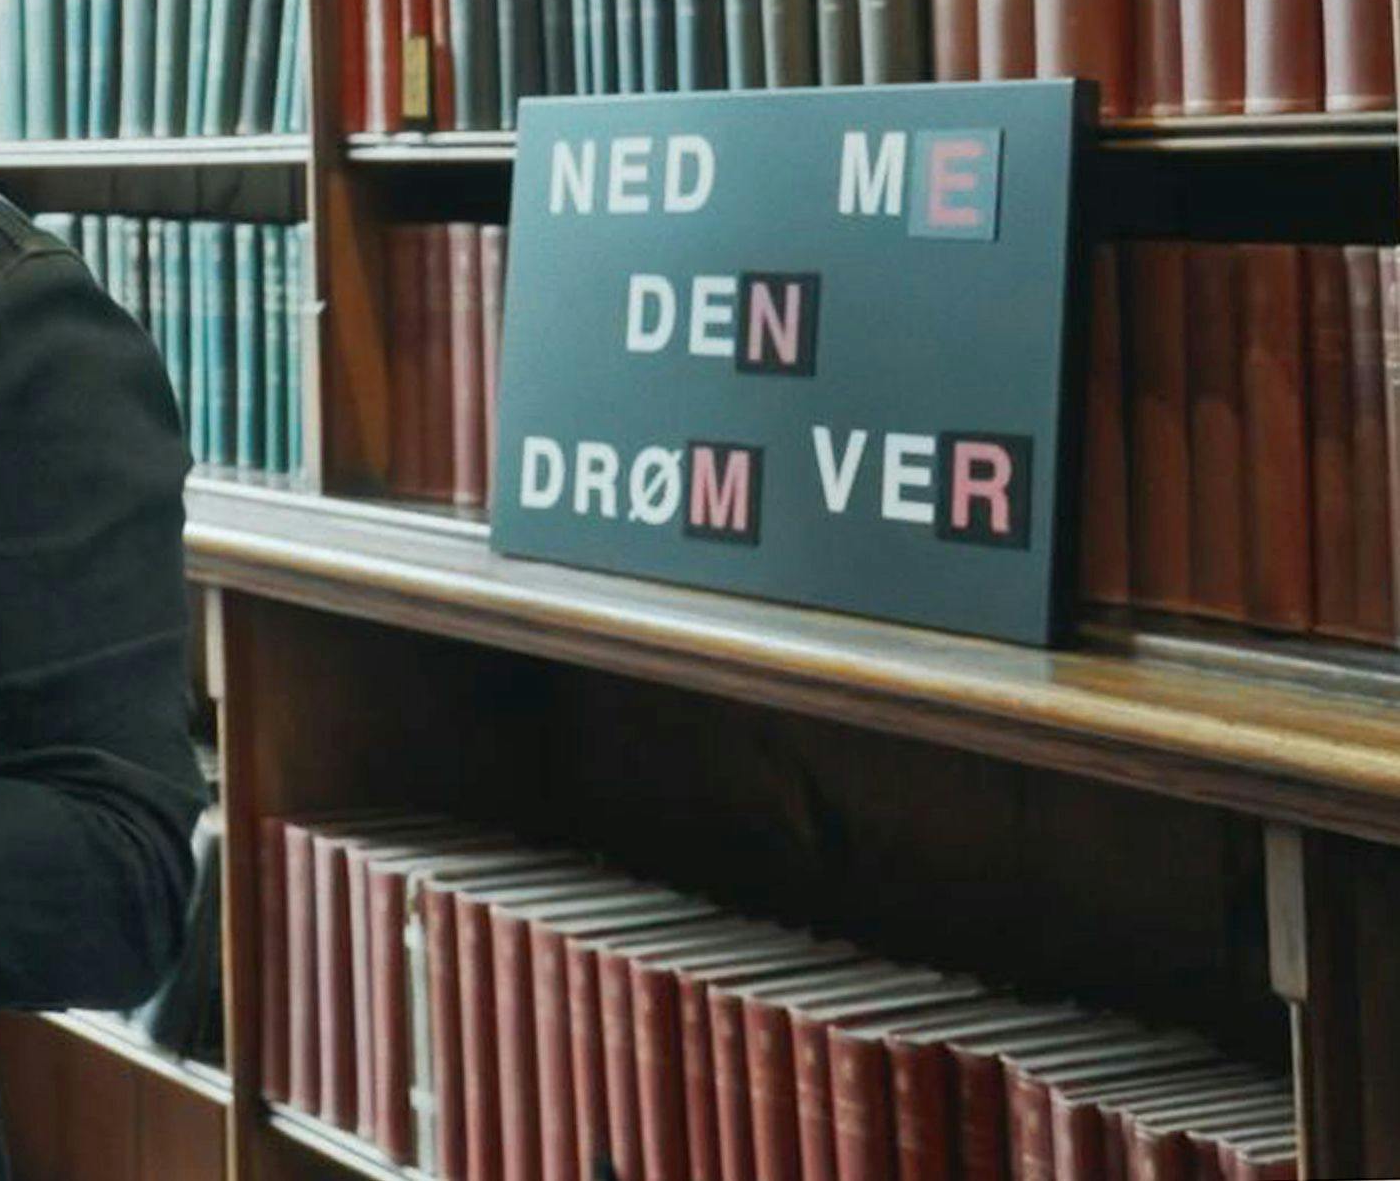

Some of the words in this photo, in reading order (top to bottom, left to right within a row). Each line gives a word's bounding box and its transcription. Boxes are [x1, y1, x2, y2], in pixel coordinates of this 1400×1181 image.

[549, 135, 715, 215] NED
[838, 131, 987, 227] ME
[626, 273, 801, 365] DEN
[520, 435, 752, 532] DRØM
[812, 426, 1014, 533] VER
